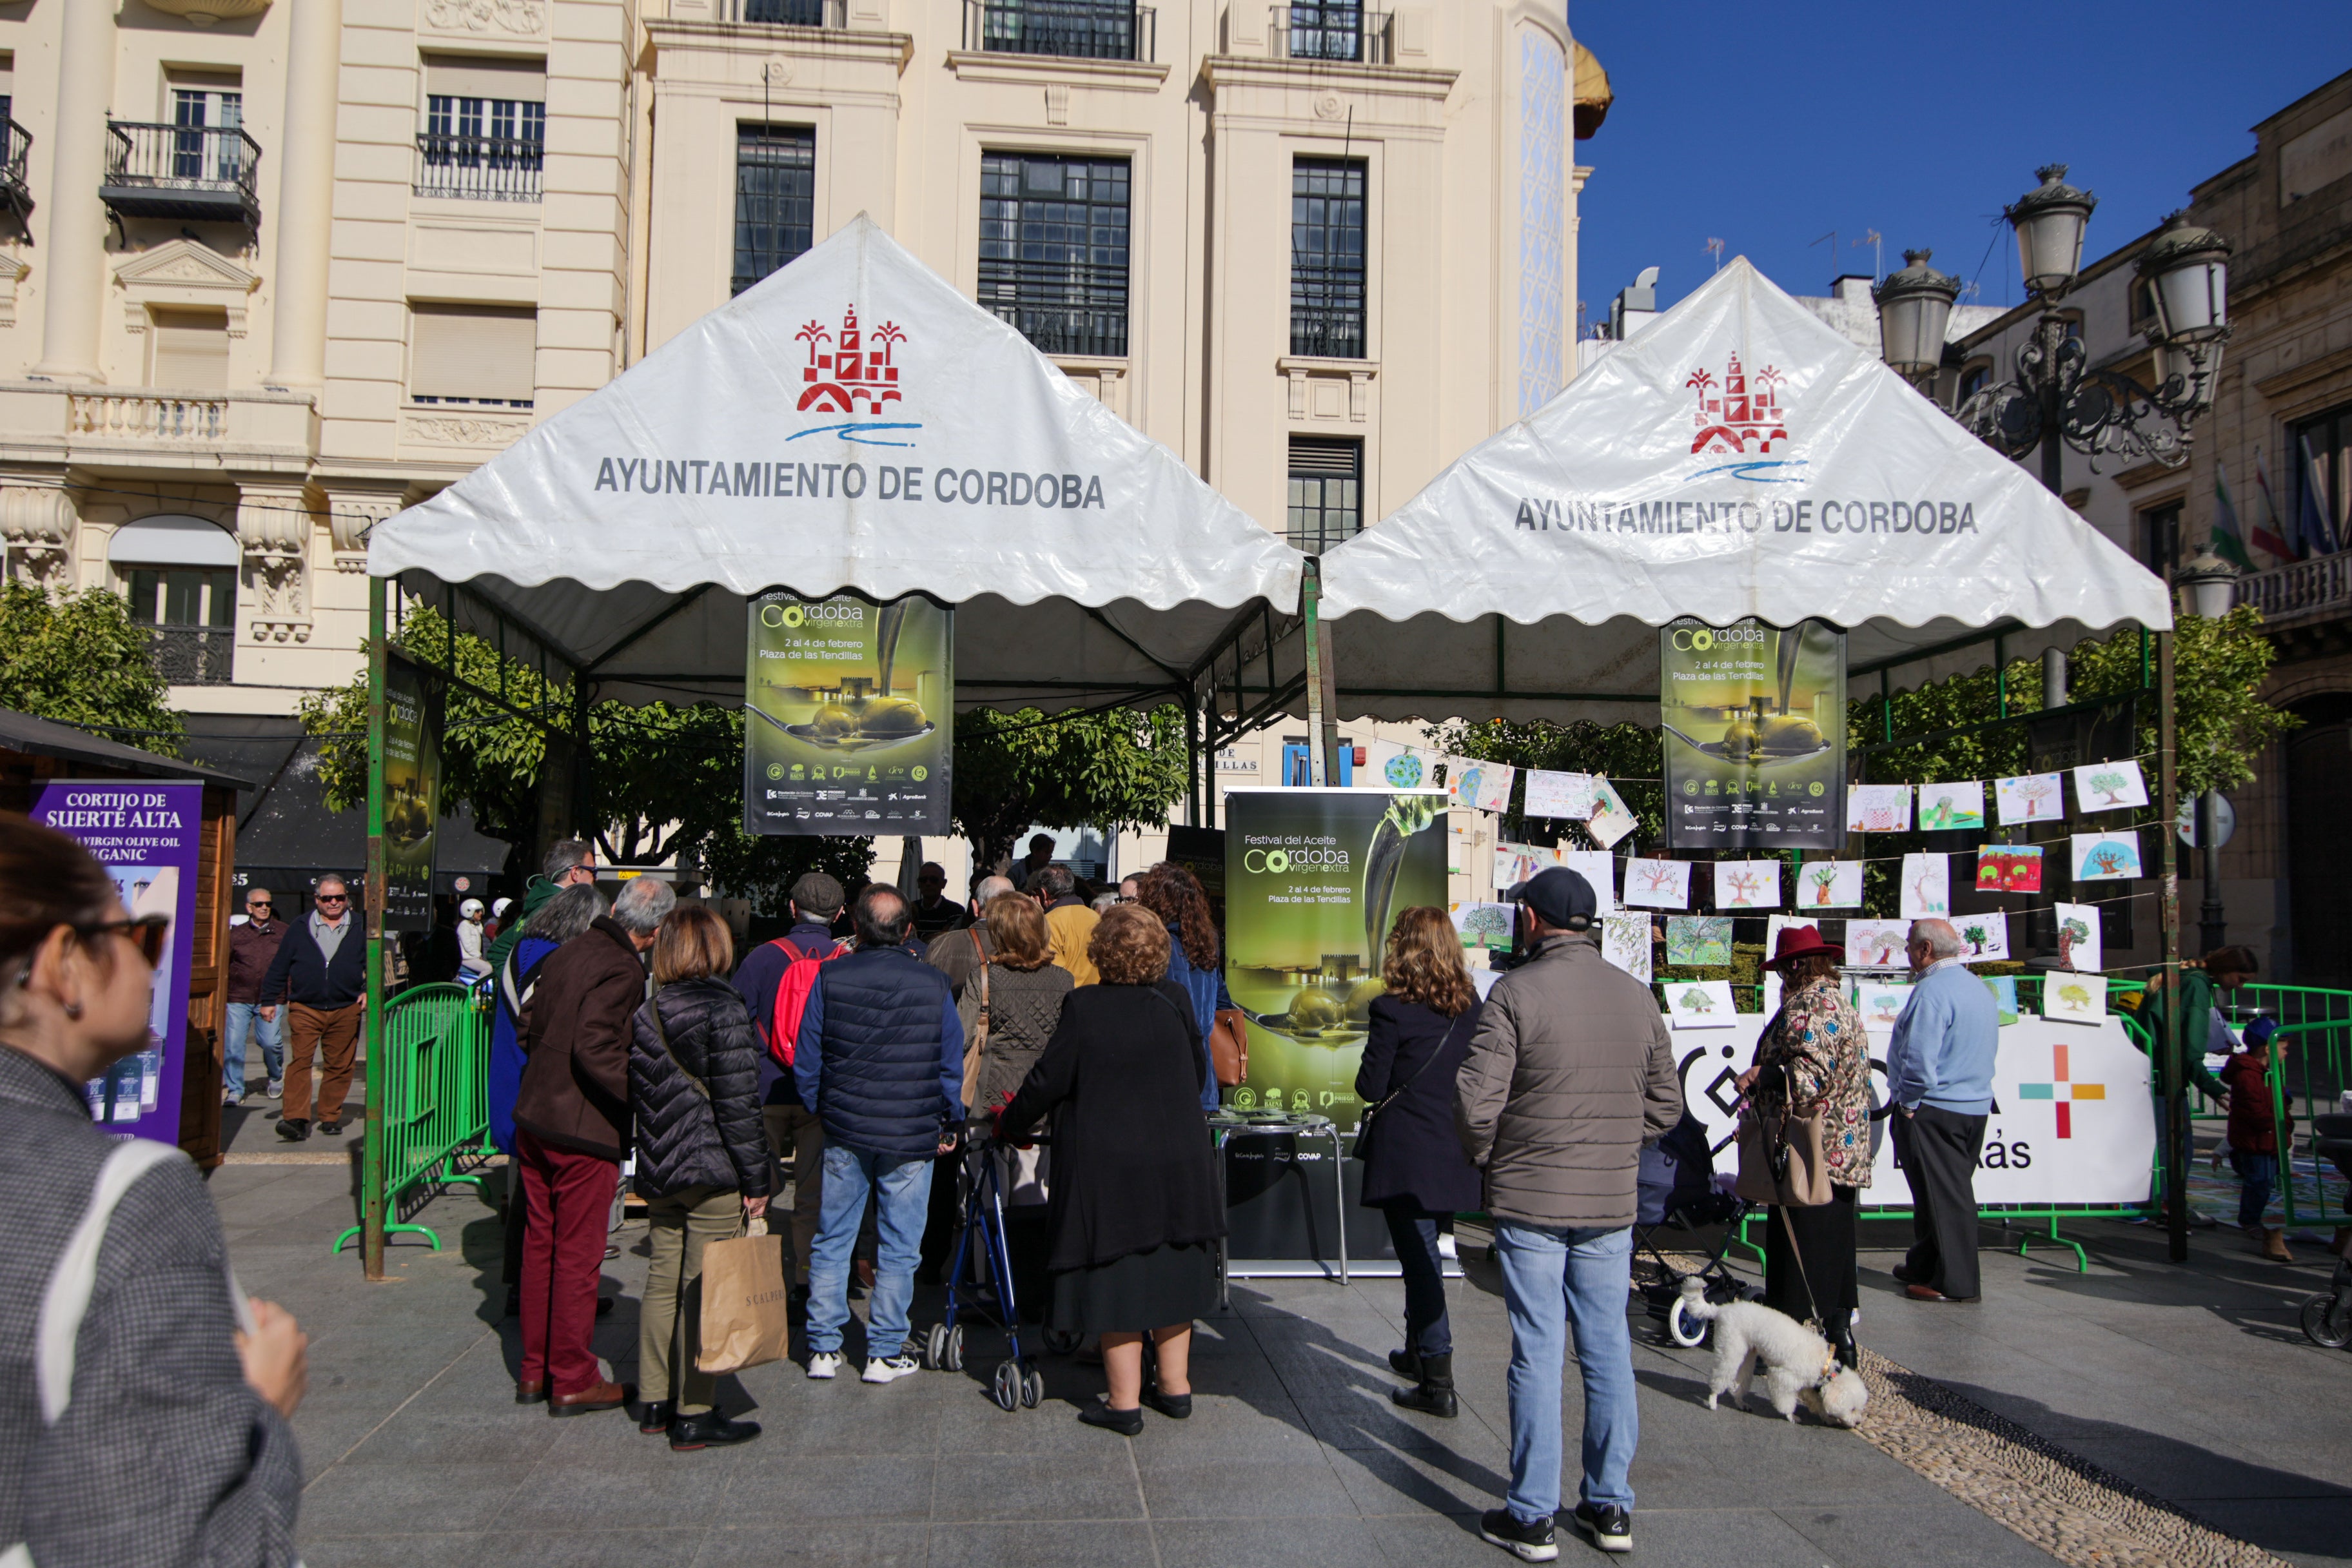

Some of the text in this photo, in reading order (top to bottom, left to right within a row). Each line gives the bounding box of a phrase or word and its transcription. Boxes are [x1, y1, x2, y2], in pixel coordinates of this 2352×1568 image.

[594, 456, 1106, 509] AYUNTAMIENTO DE CORDOBA
[1514, 496, 1979, 535] AYUNTAMIENTO DE CORDOBA
[761, 603, 863, 628] Córdoba
[785, 638, 863, 648] 2 al 4 de febrero
[1672, 626, 1765, 651] Córdoba
[760, 649, 863, 660] Plaza de las Tendillas
[1695, 660, 1764, 669] 2 al 4 de febrero
[1672, 671, 1764, 681] Plaza de las Tendillas
[1219, 749, 1235, 757] DE
[66, 793, 166, 810] CORTIJO DE
[46, 810, 183, 828] SUERTE ALTA
[83, 836, 124, 847] VIRGIN
[125, 837, 159, 847] OLIVE
[161, 837, 181, 847] OIL
[1244, 835, 1337, 845] Festival del Aceite
[1244, 847, 1349, 874] Córdoba
[1289, 863, 1349, 874] virgenextra
[1323, 885, 1351, 894] febrero
[1317, 895, 1351, 903] Tendillas
